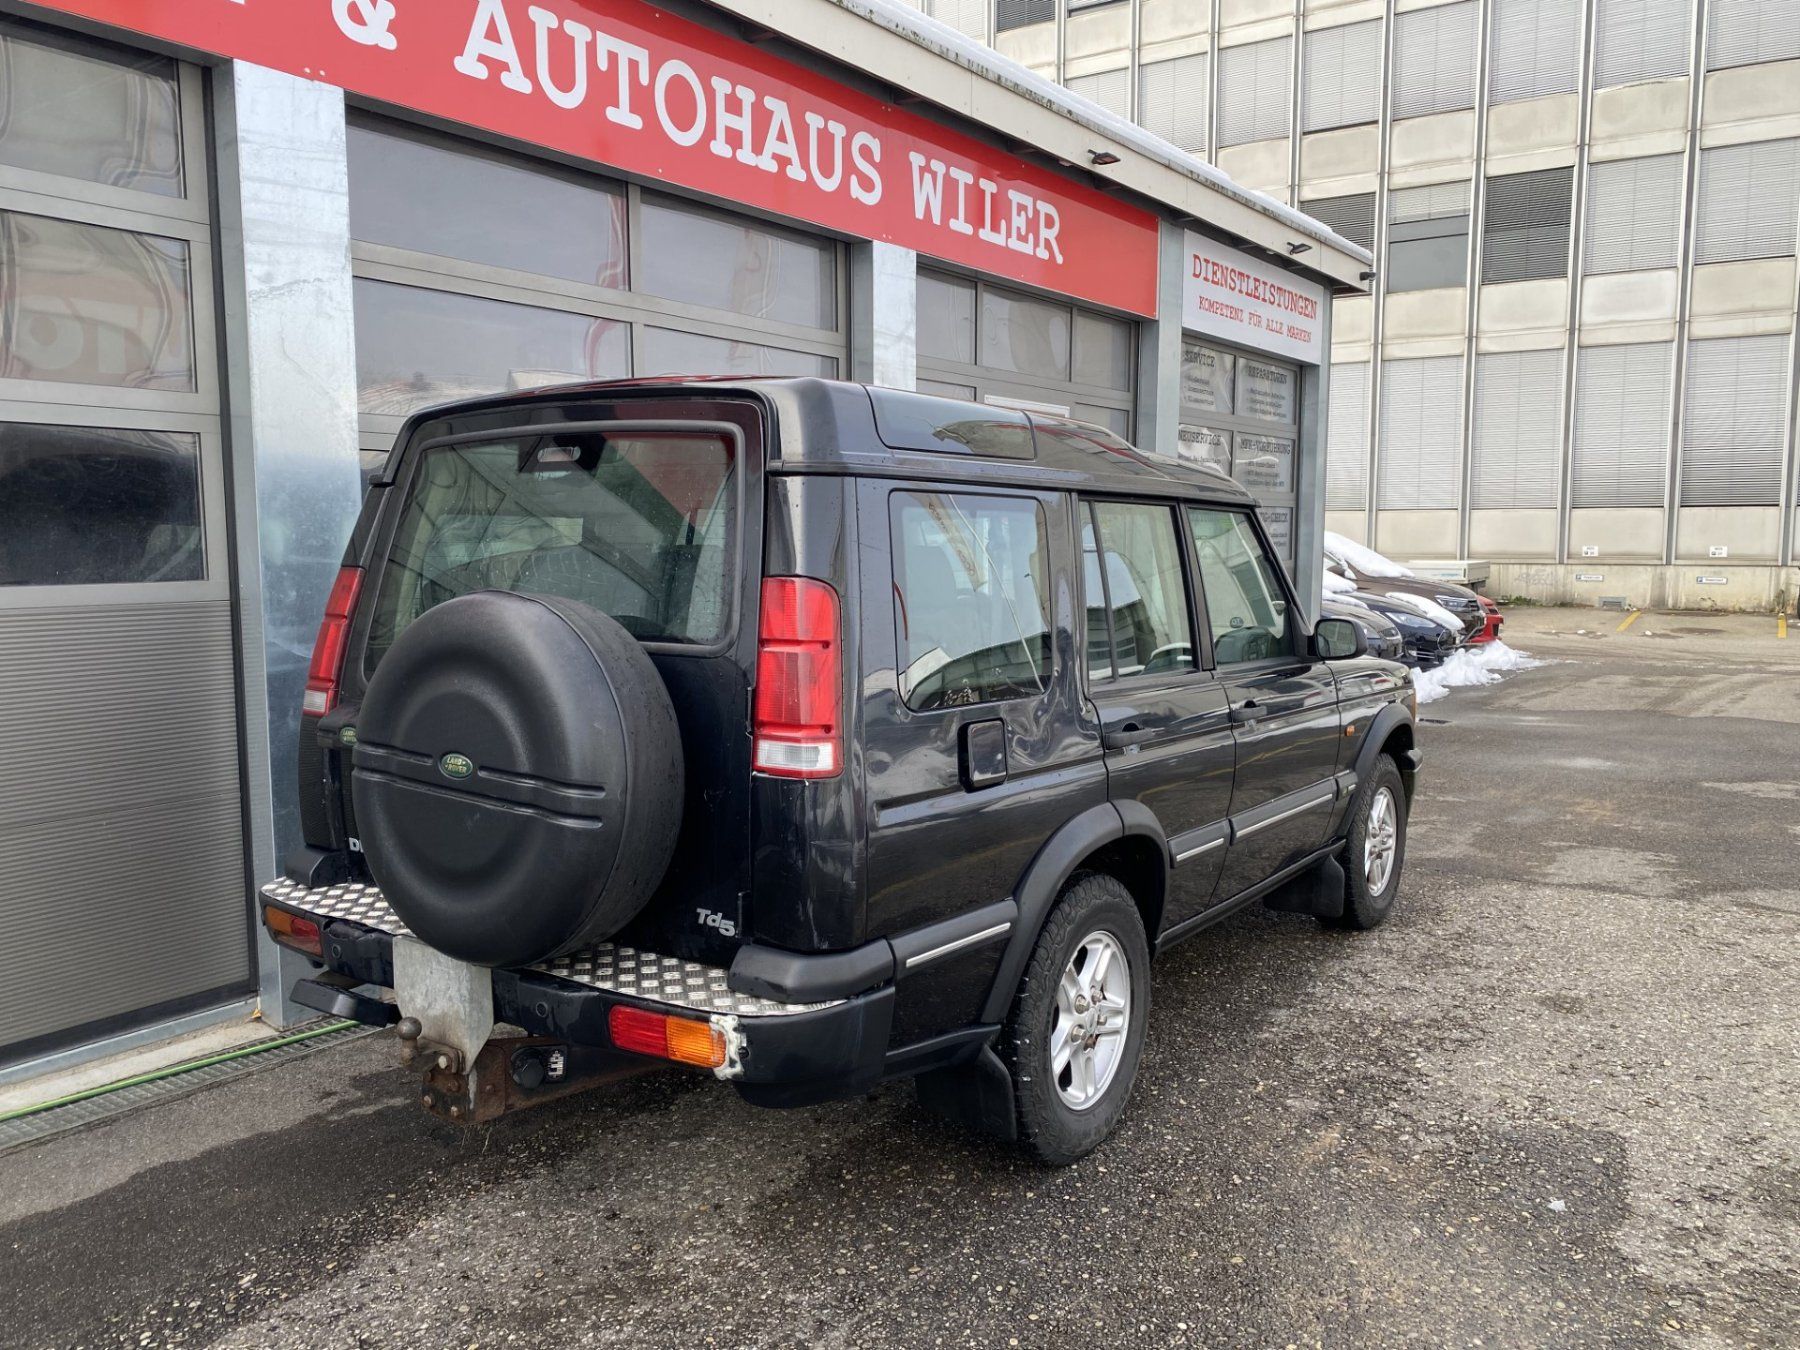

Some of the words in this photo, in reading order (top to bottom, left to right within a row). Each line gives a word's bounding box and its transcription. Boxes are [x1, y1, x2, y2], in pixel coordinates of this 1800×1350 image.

[453, 0, 883, 206] AUTOHAUS
[908, 151, 1064, 265] WILER
[1192, 254, 1318, 320] DIENSTLEISTUNGEN
[1198, 296, 1244, 323] KOMPETENZ
[1248, 310, 1263, 327] FÜR
[1265, 318, 1284, 335] ALLE
[1286, 325, 1312, 343] MARKEN
[1184, 351, 1215, 367] SERVICE
[446, 756, 463, 765] LAND
[447, 764, 468, 774] ROVER
[695, 907, 736, 937] Td5
